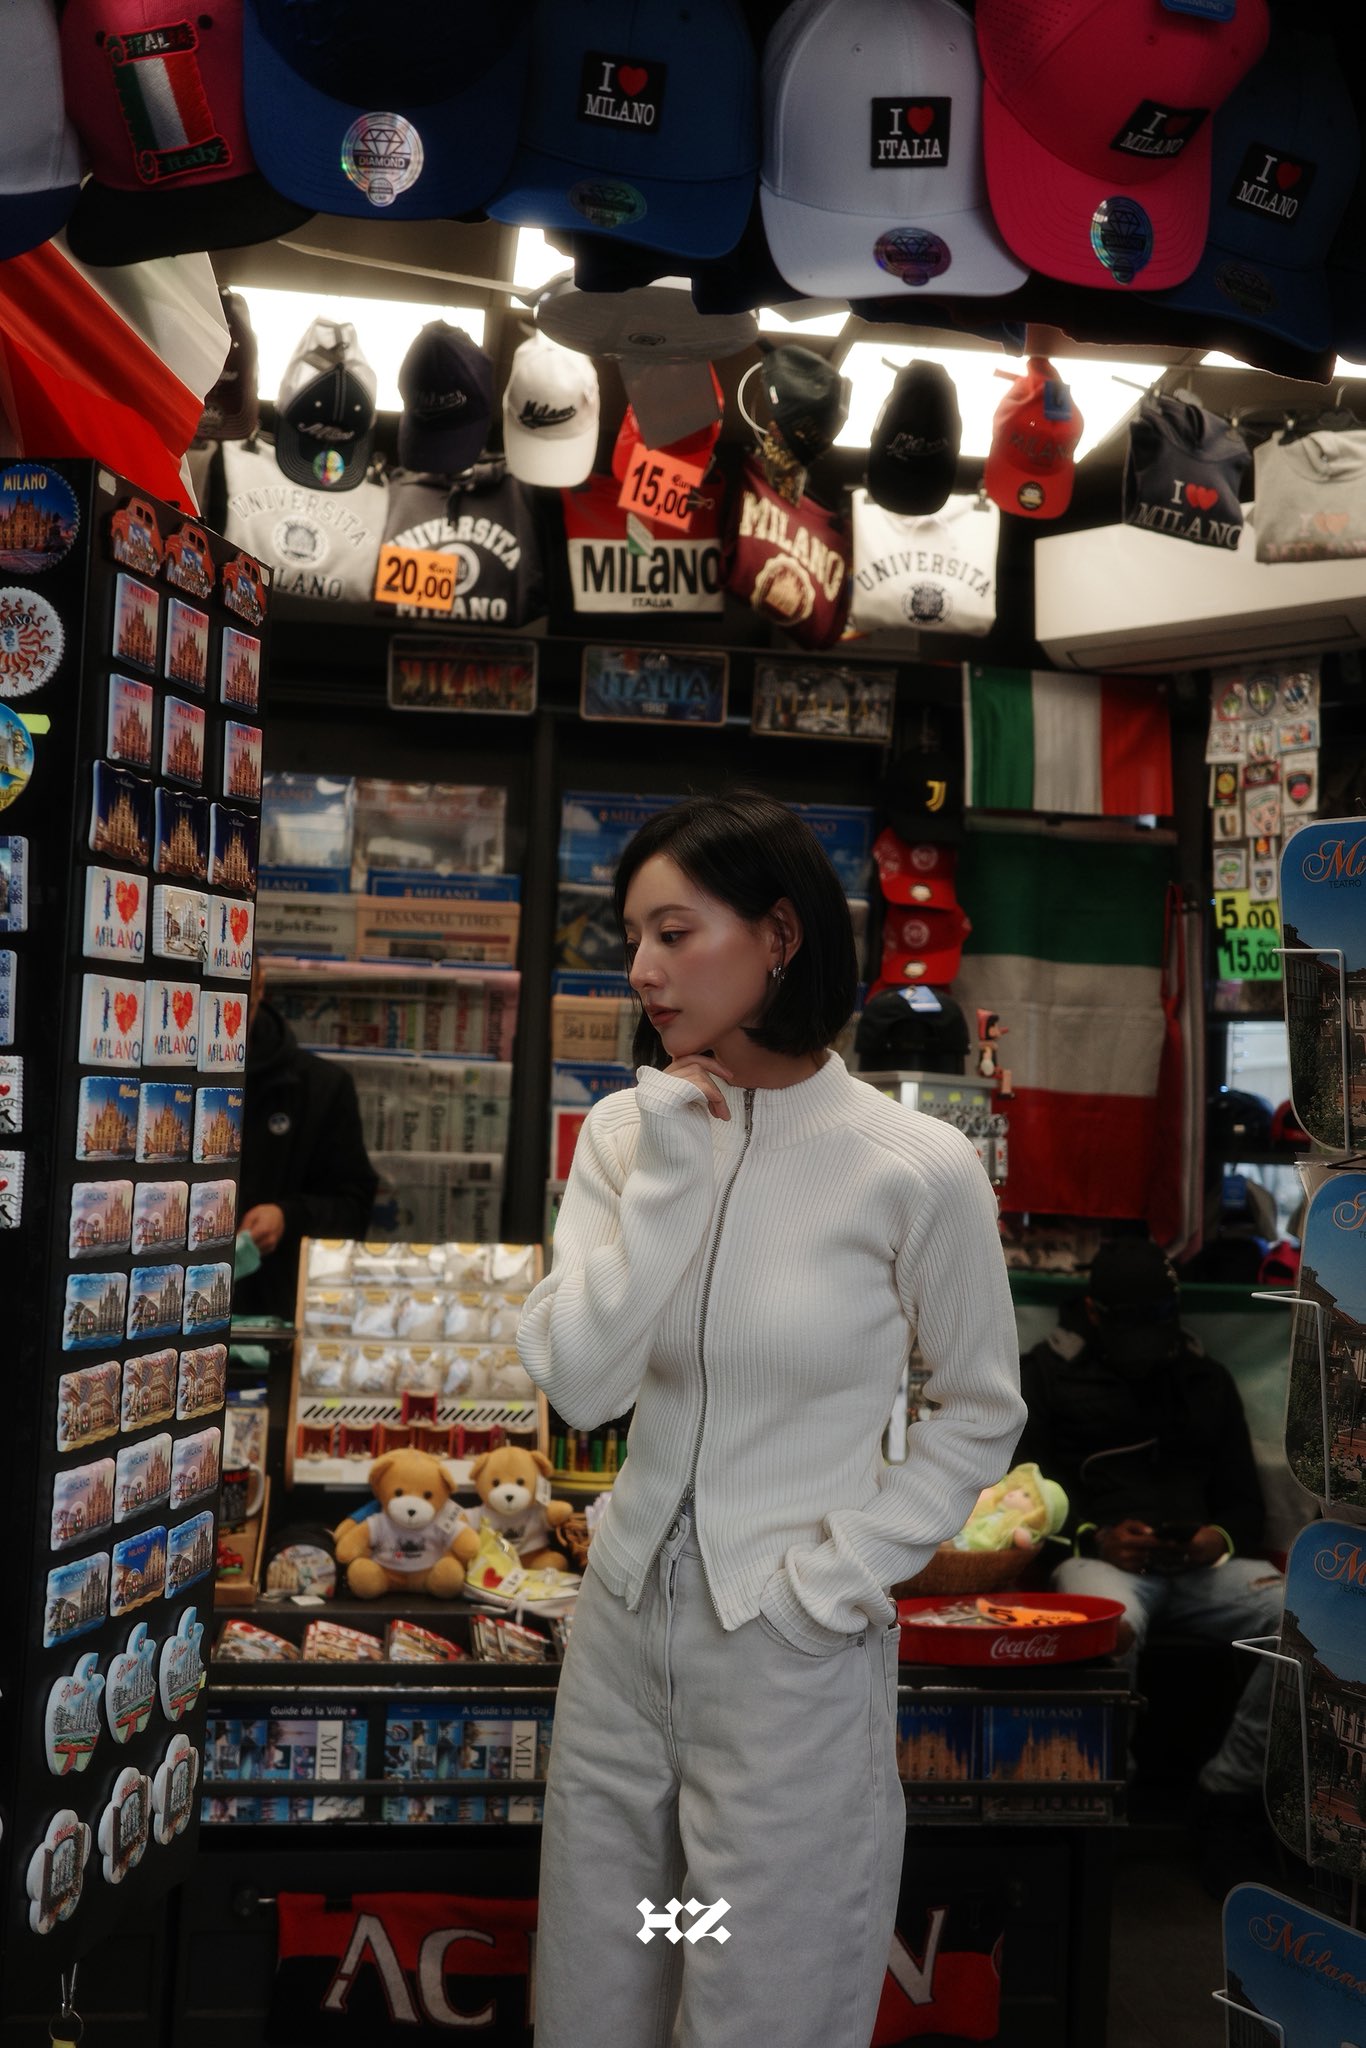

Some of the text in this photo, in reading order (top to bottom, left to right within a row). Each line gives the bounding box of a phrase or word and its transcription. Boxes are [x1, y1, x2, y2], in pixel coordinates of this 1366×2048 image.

[598, 62, 615, 92] I
[585, 94, 656, 126] MILANO
[889, 108, 902, 135] I
[1142, 111, 1167, 134] I
[878, 138, 942, 160] ITALIA
[1119, 132, 1184, 154] MILANO
[359, 156, 406, 168] DIAMOND
[1256, 154, 1278, 183] I
[1236, 181, 1299, 219] MILANO
[520, 401, 577, 428] Milano
[3, 473, 48, 491] MILANO
[631, 461, 690, 517] 15,00
[1170, 479, 1185, 504] I
[739, 490, 845, 602] MILANO
[386, 556, 451, 601] 20,00
[856, 551, 991, 598] UNIVERSITA
[632, 598, 673, 609] ITALIA
[601, 669, 708, 700] ITALIA
[103, 875, 113, 921] I
[1328, 880, 1362, 889] TEATRO
[220, 903, 228, 943] I
[374, 909, 505, 927] FINANCIAL TIMES
[95, 924, 143, 952] MILANO
[214, 947, 251, 971] MILANO
[1223, 938, 1279, 976] 15,00
[101, 987, 112, 1032] I
[161, 987, 170, 1029] I
[214, 998, 222, 1039] I
[93, 1036, 141, 1063] MILANO
[154, 1034, 197, 1056] MILANO
[208, 1041, 245, 1063] MILANO
[270, 1706, 348, 1716] Guide de la Ville
[462, 1706, 549, 1717] A Guide to the City
[1023, 1706, 1082, 1719] MILANO
[323, 1913, 495, 2028] AC
